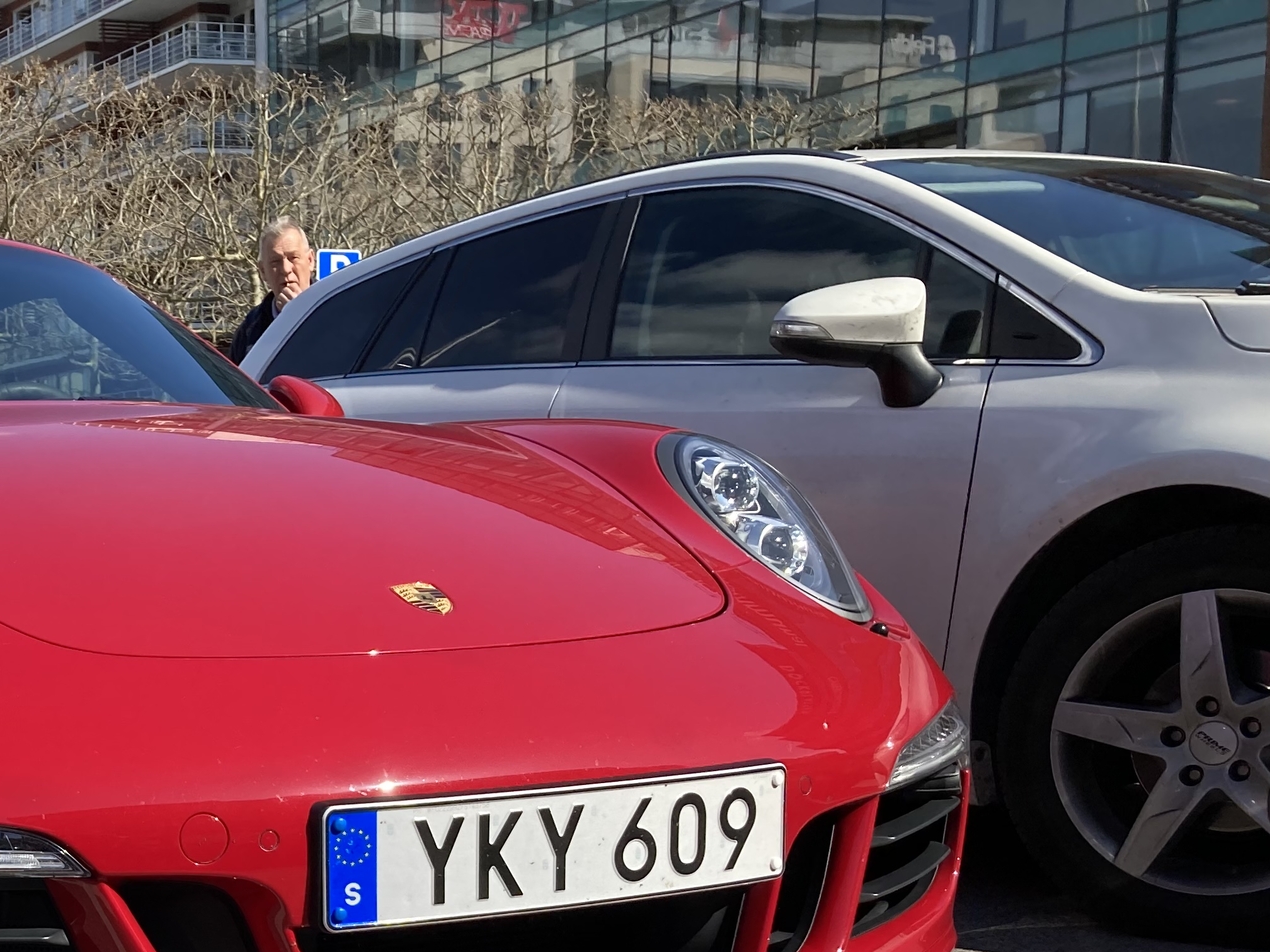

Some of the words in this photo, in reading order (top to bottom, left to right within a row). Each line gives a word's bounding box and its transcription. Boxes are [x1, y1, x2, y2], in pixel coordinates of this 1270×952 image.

[1197, 731, 1231, 753] PRIME
[415, 805, 586, 905] YKY
[612, 786, 758, 883] 609
[345, 882, 361, 906] S
